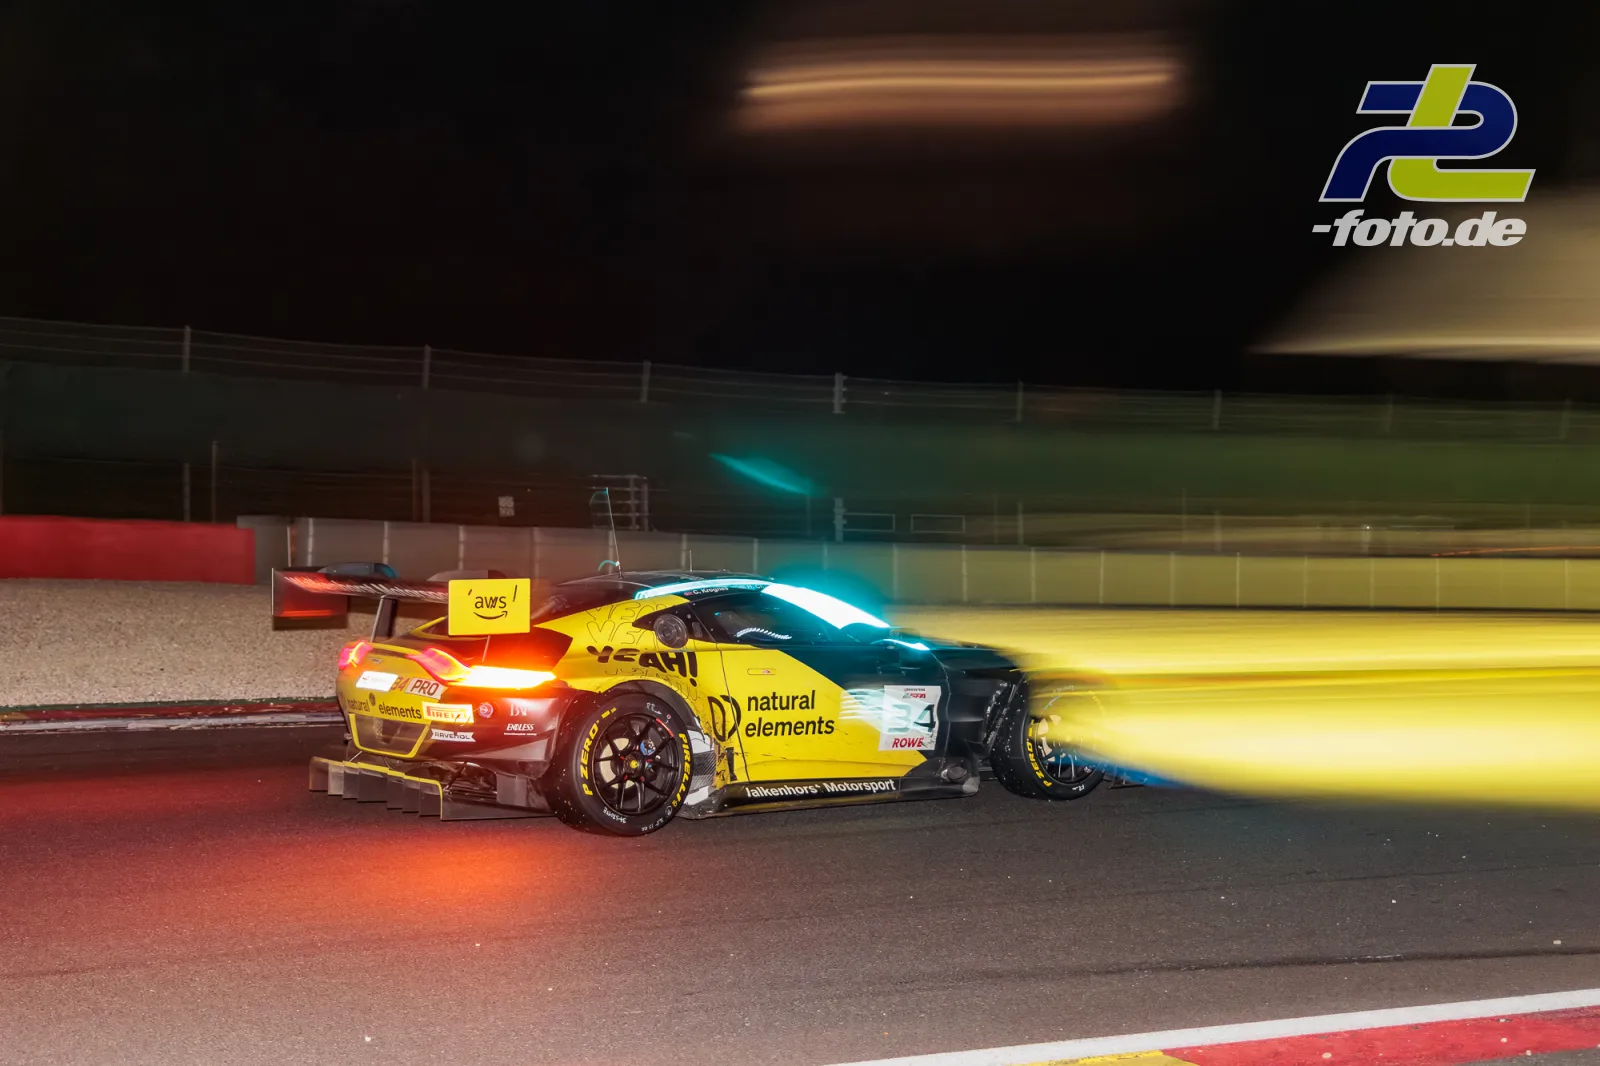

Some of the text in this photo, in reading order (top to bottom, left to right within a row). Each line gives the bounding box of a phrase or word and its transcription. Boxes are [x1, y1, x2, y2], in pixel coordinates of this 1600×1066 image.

[474, 596, 507, 609] aws
[586, 645, 698, 687] YEAH!
[410, 679, 440, 697] PRO
[378, 702, 422, 720] elements
[747, 690, 816, 712] natural
[506, 723, 535, 732] ENDLESS
[745, 716, 835, 738] elements
[887, 703, 936, 732] 34
[891, 737, 924, 749] ROWE
[580, 722, 600, 796] P ZERO
[1026, 741, 1045, 779] ZERO
[823, 779, 897, 795] Motorsport
